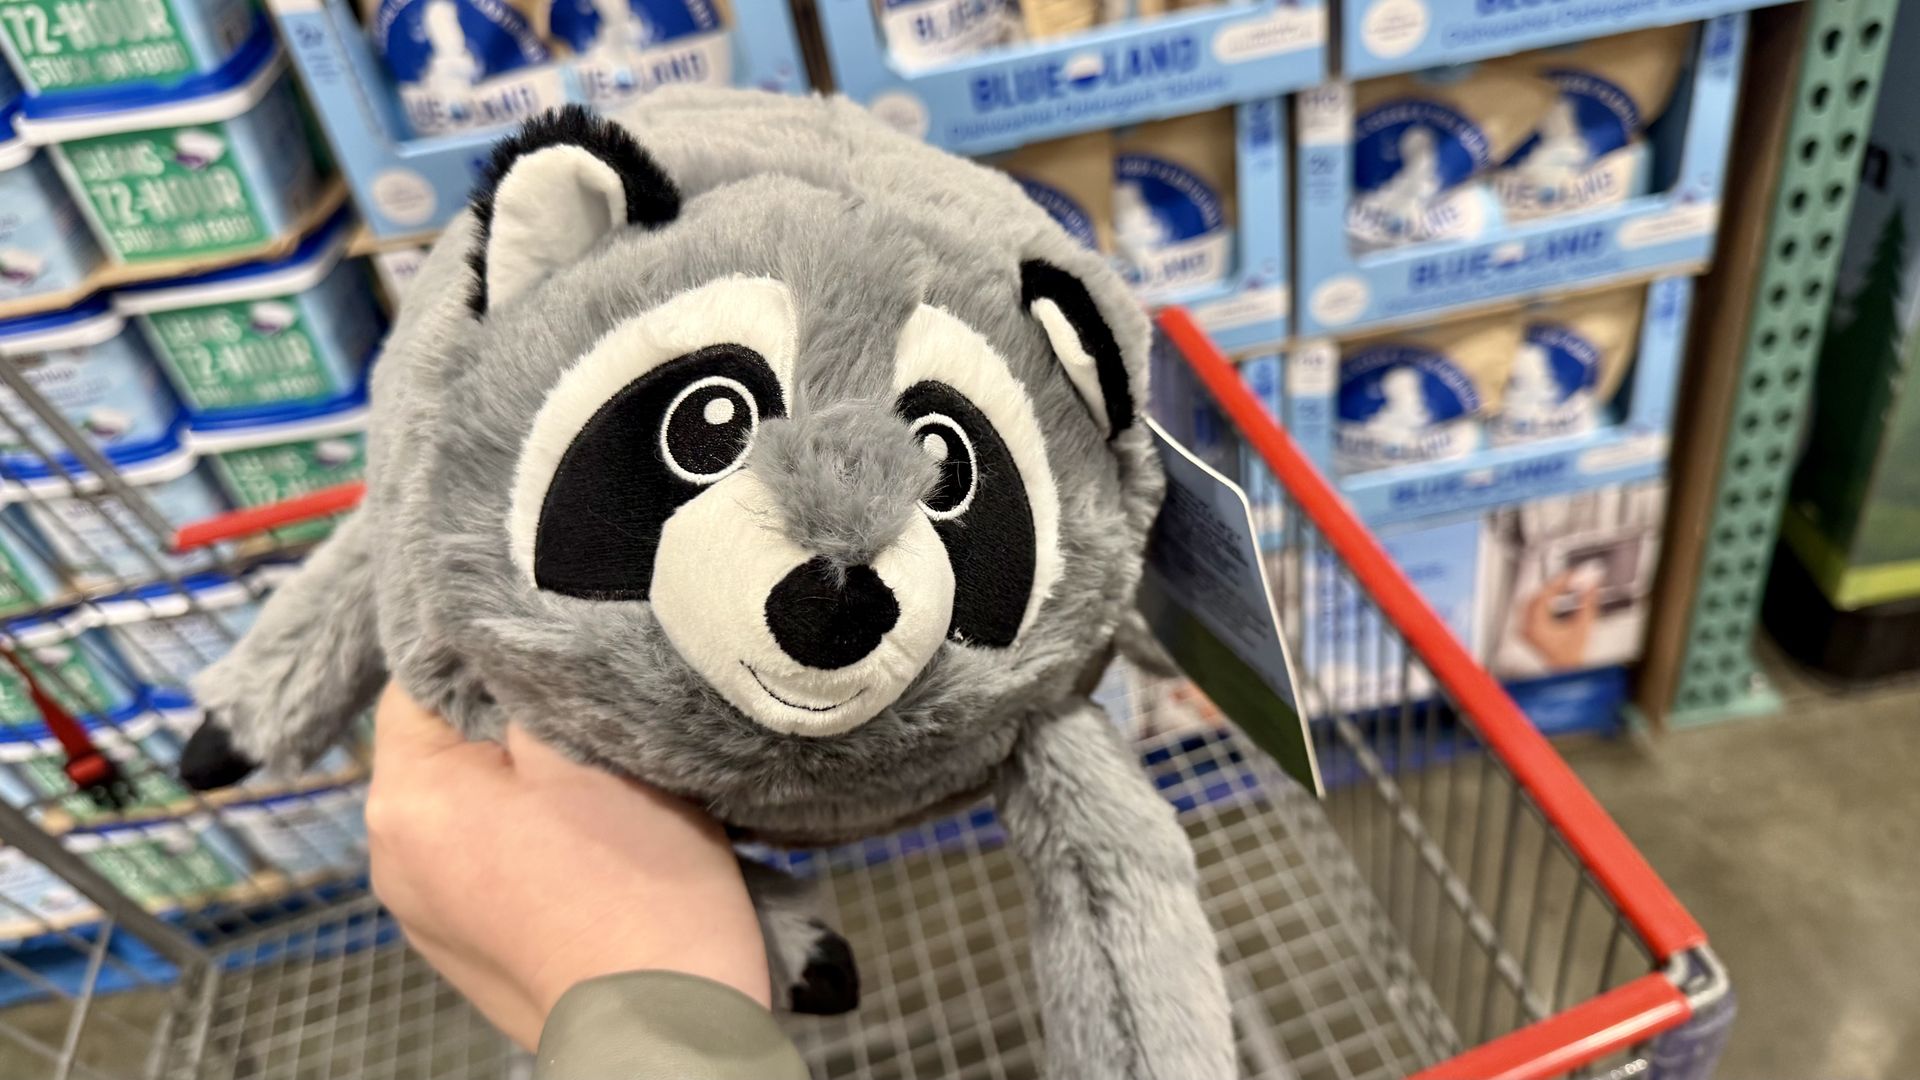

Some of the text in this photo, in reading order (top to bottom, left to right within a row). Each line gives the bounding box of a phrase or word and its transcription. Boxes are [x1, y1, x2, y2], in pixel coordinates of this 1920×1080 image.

[2, 0, 175, 54] 72-HOUR
[969, 62, 1064, 114] BLUE
[1102, 33, 1199, 88] LAND
[88, 165, 247, 226] 72-HOUR
